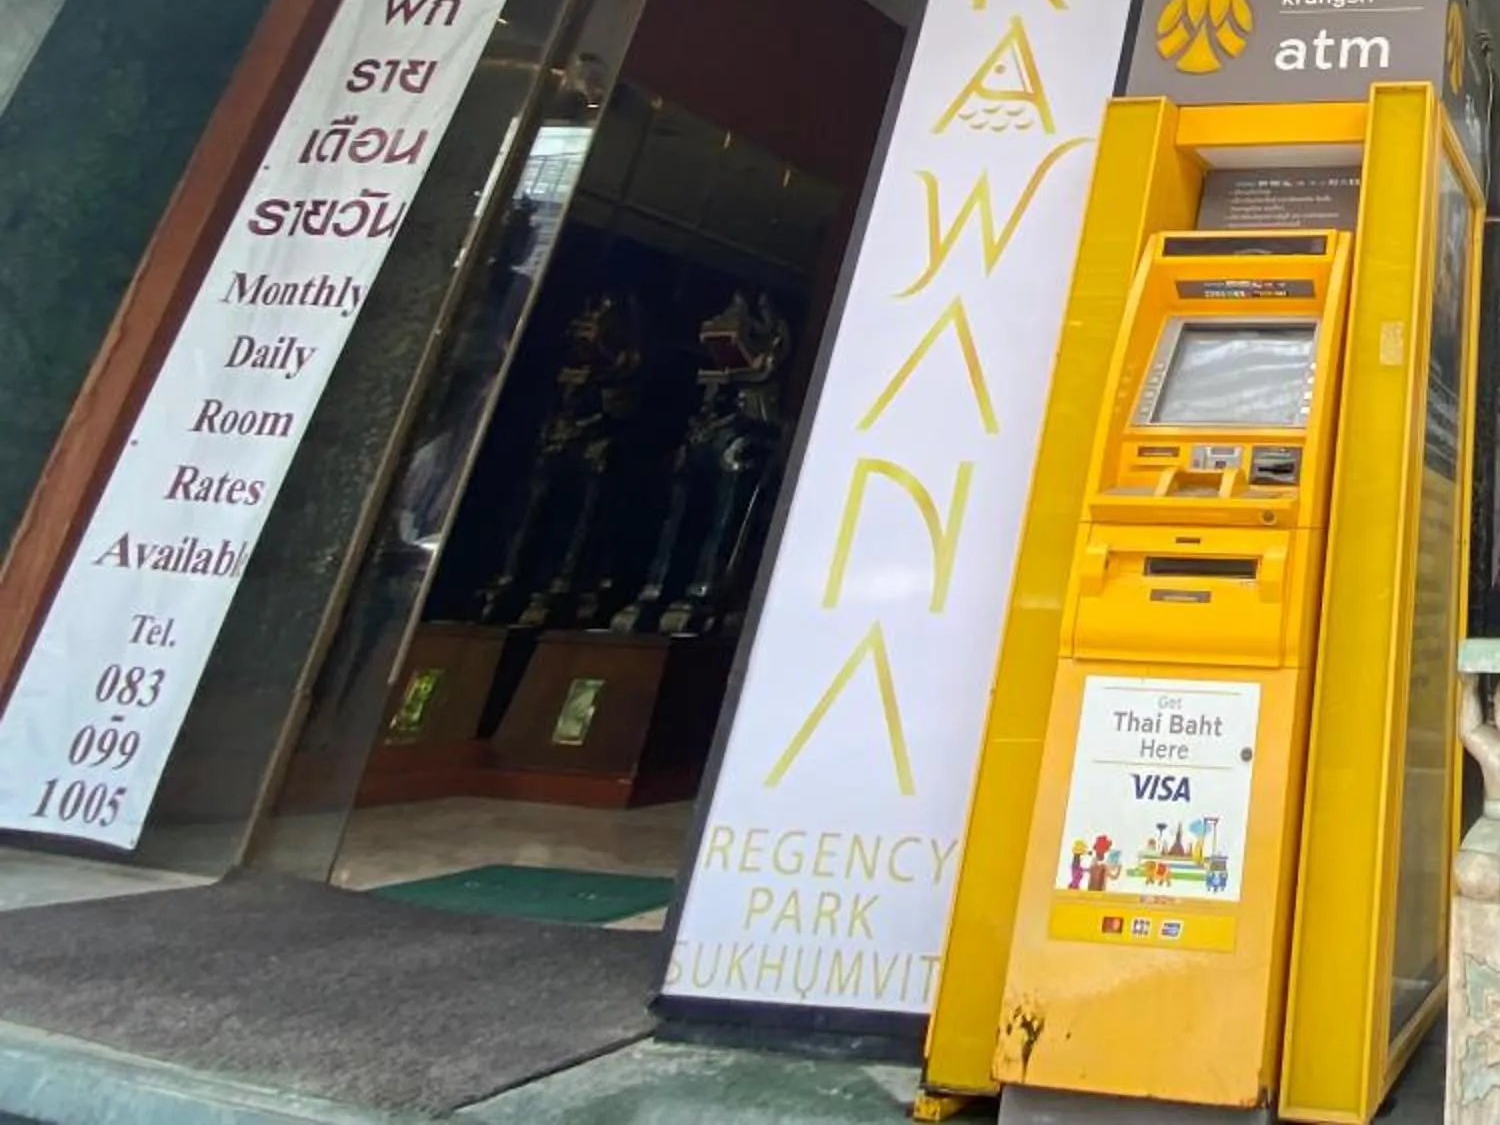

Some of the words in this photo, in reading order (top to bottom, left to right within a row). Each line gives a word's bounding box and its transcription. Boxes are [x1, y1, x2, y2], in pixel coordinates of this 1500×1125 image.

[1275, 29, 1390, 71] atm
[346, 59, 437, 93] ราย
[299, 115, 428, 164] เดือน
[248, 188, 406, 238] รายวัน
[219, 270, 367, 317] Monthly
[224, 335, 318, 379] Daily
[190, 399, 294, 437] Room
[164, 465, 266, 506] Rates
[127, 614, 177, 648] Tel.
[95, 664, 166, 708] 083
[1158, 695, 1183, 710] Get
[1114, 710, 1161, 735] Thai
[1169, 714, 1223, 737] Baht
[68, 725, 140, 770] 099
[1140, 739, 1189, 760] Here
[30, 778, 128, 827] 1005
[1130, 773, 1191, 803] VISA
[704, 826, 958, 884] REGENCY
[744, 887, 879, 939] PARK
